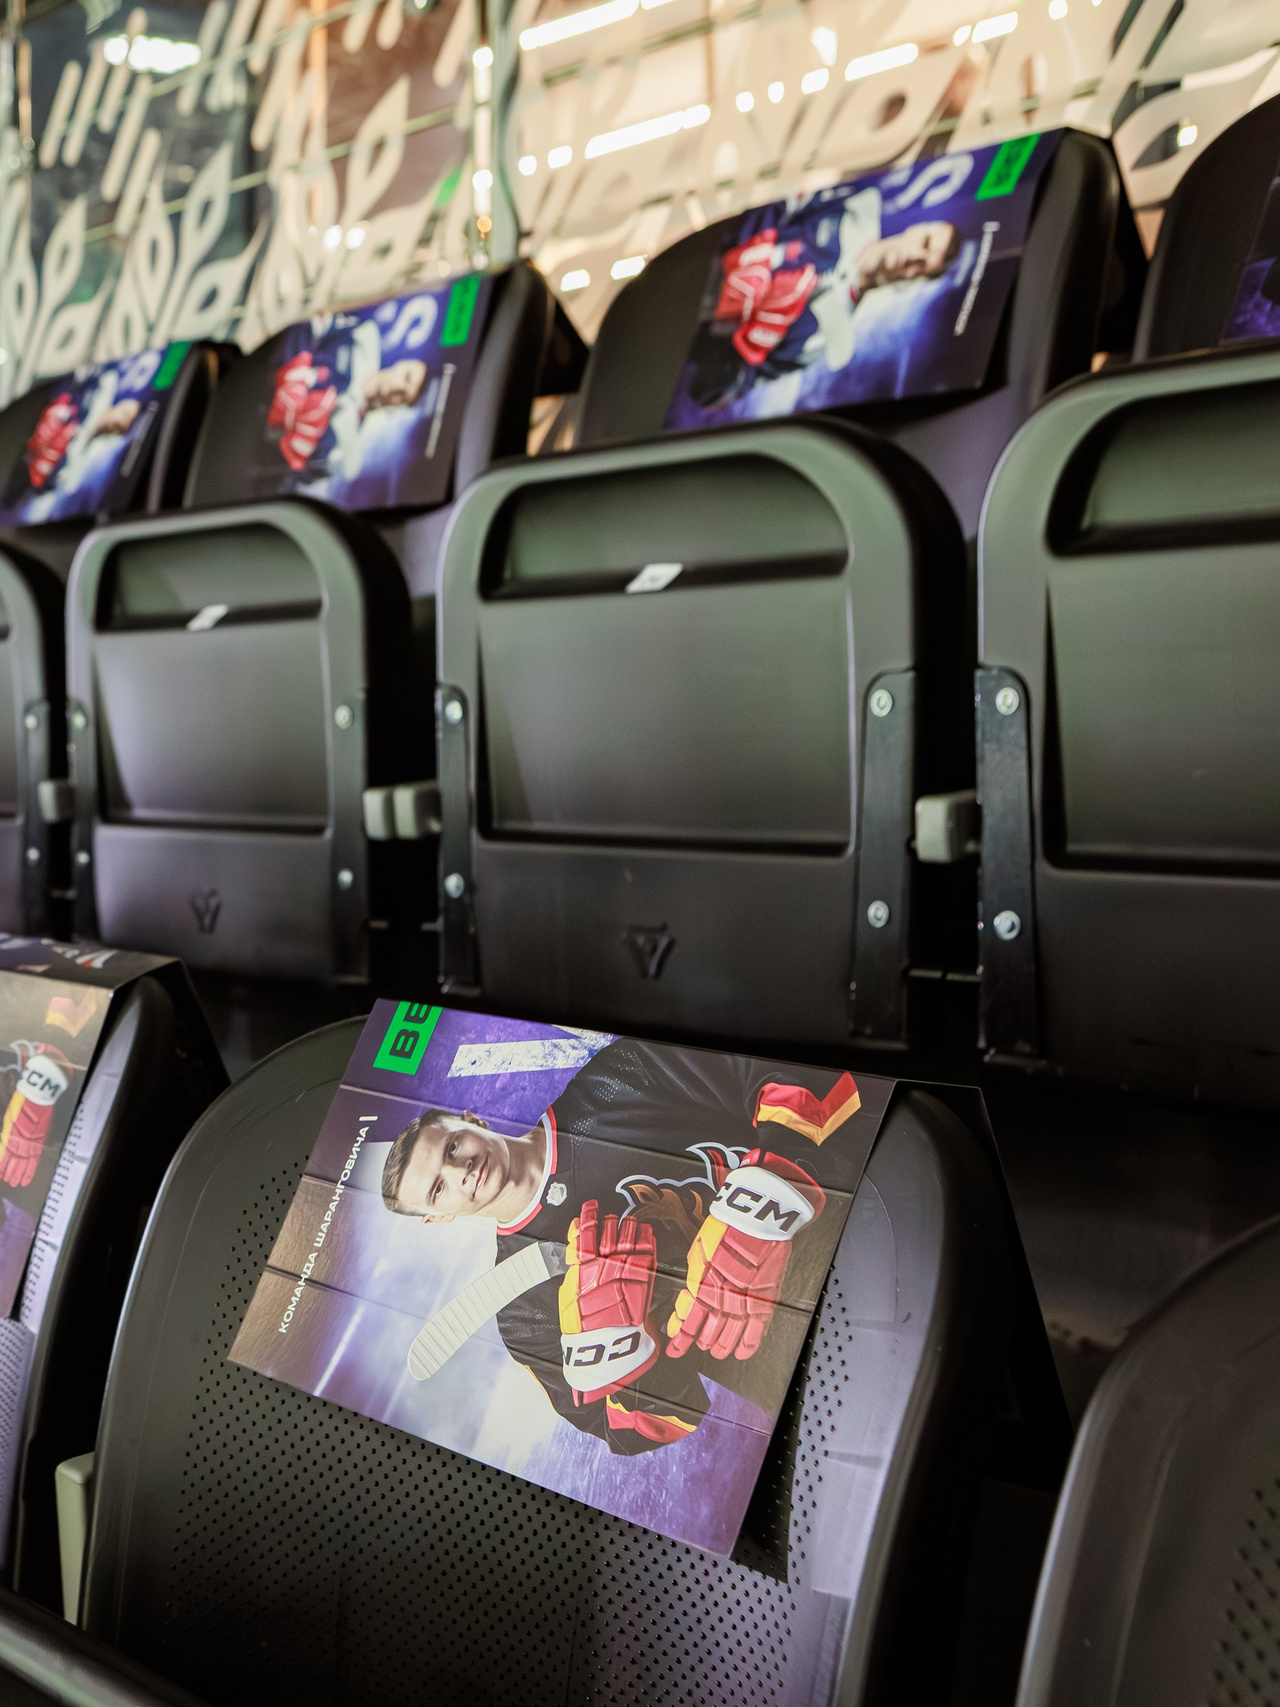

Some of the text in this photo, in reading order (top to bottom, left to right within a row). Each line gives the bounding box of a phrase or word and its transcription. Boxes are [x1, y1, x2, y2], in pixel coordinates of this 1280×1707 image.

[18, 1066, 60, 1098] CM
[278, 1126, 370, 1334] КОМАНДА ШАРАНГОВИЧА
